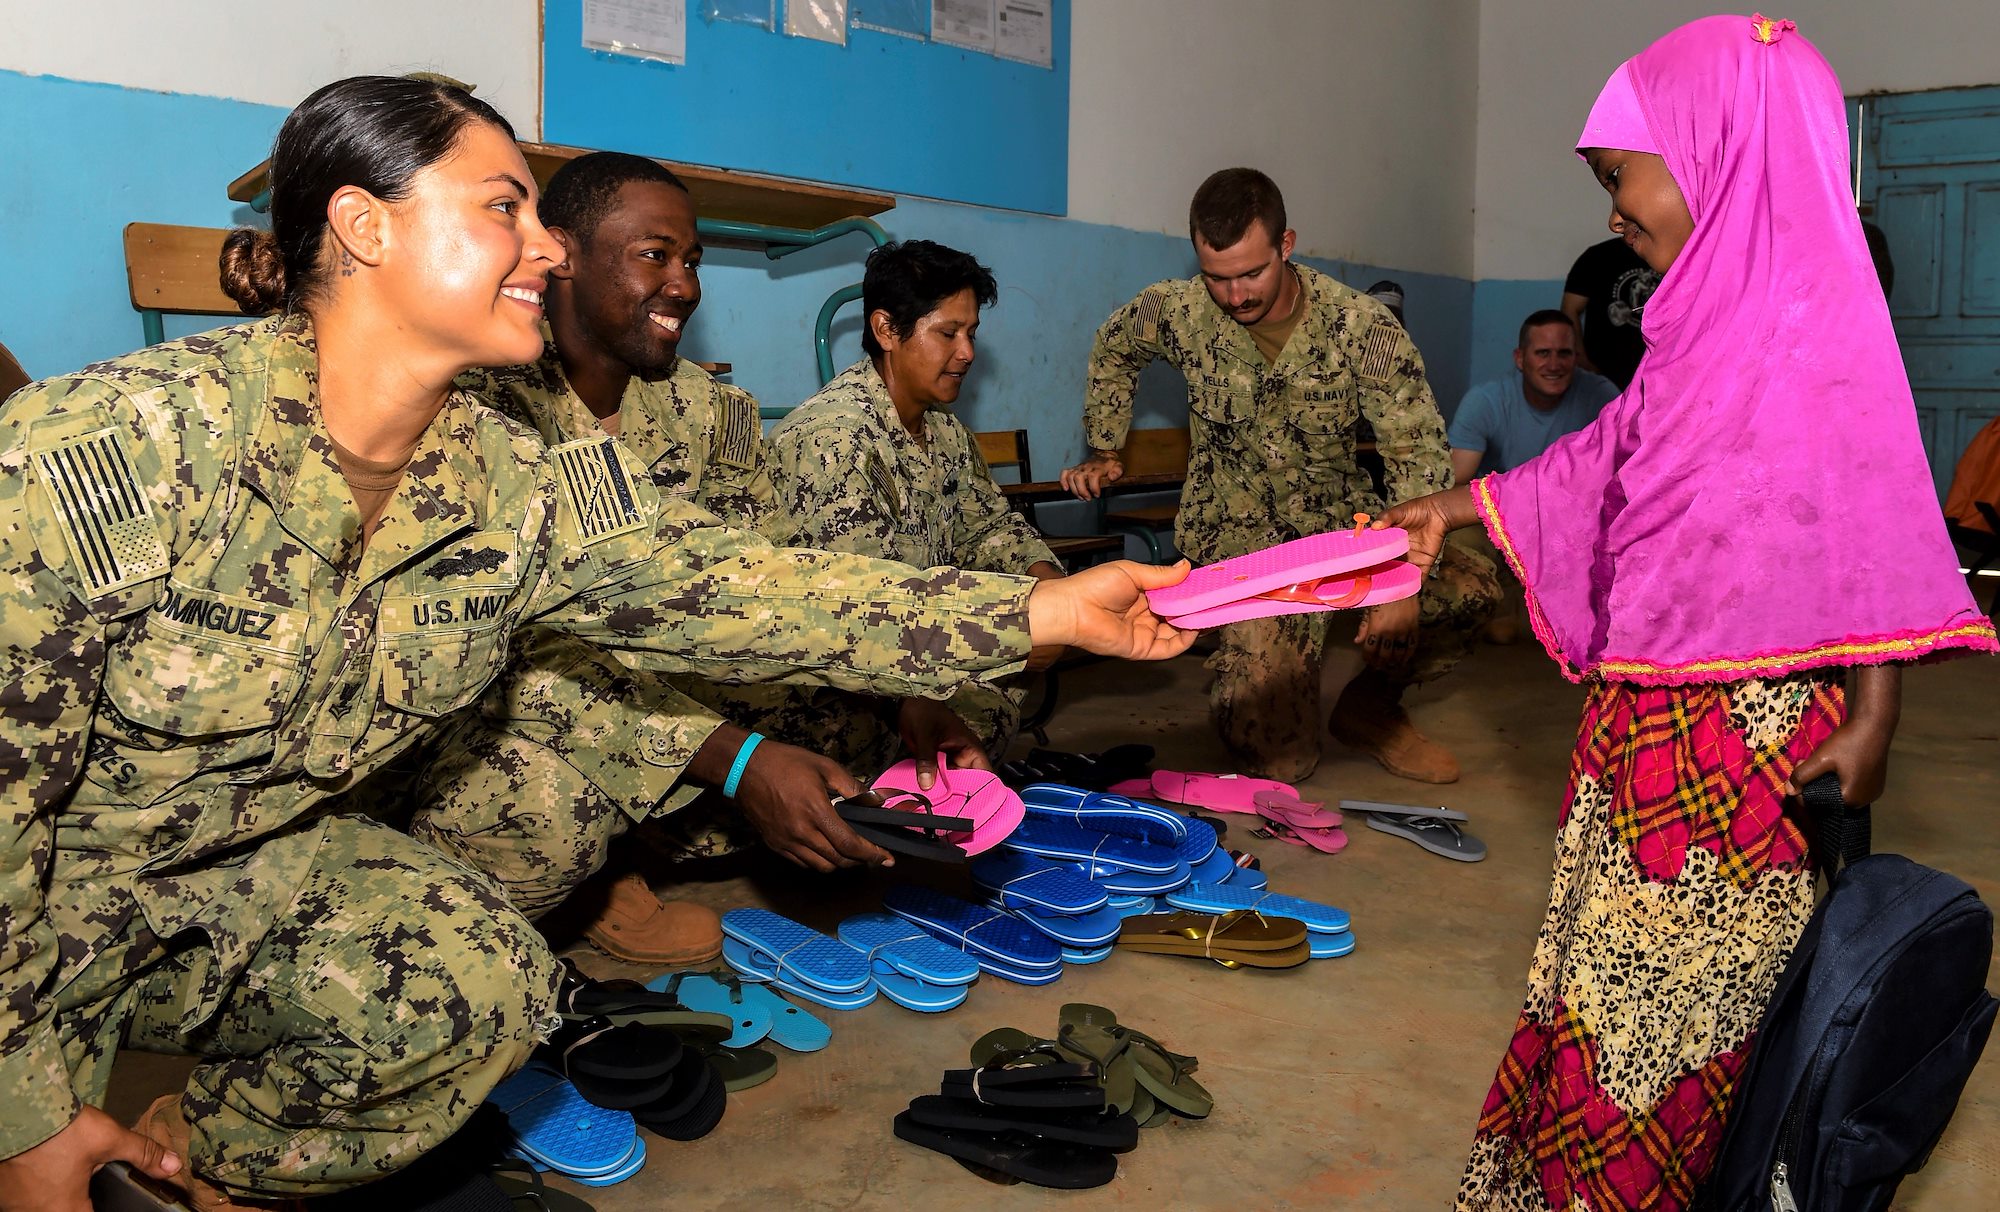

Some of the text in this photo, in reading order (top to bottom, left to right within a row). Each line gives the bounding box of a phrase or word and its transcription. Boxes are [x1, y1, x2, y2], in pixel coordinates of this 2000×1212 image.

[153, 584, 276, 641] OMINGUEZ
[413, 600, 459, 626] U.S.
[100, 756, 138, 784] ES
